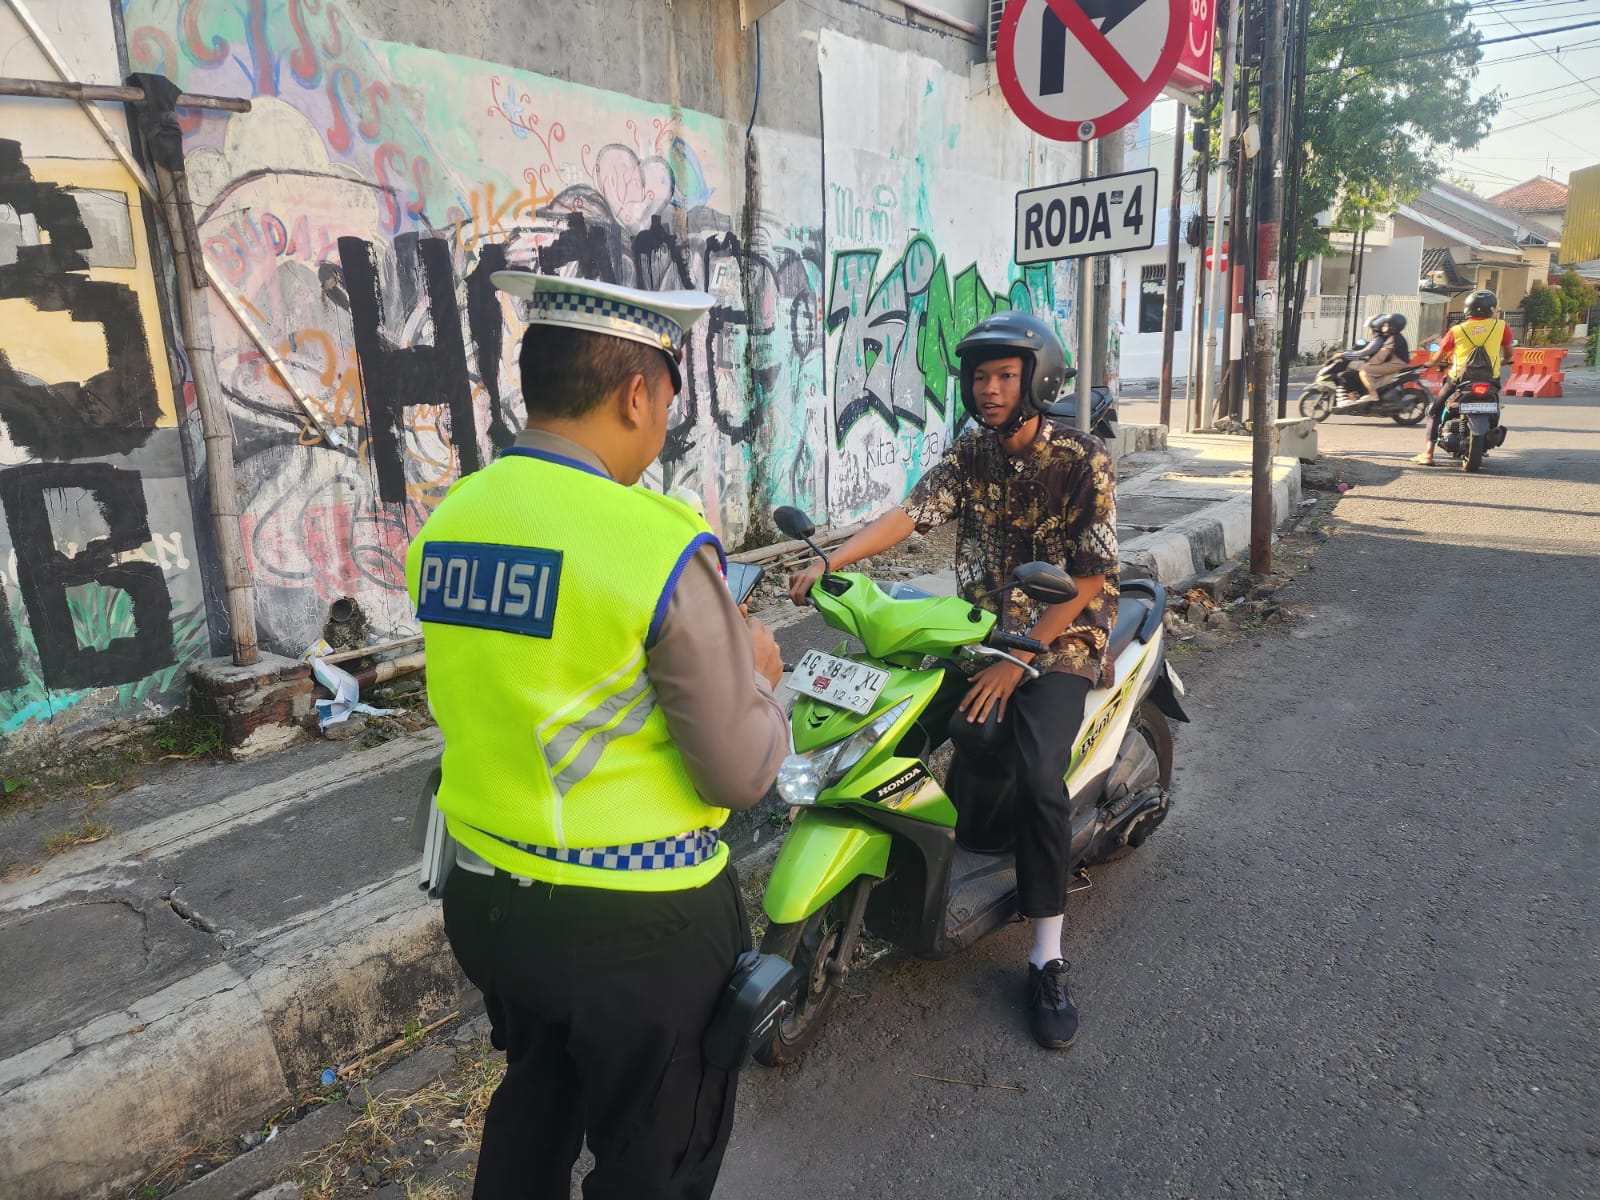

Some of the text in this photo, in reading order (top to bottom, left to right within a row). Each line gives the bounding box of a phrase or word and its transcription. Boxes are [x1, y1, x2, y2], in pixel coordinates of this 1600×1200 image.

[1025, 185, 1143, 250] RODA 4
[420, 556, 550, 619] POLISI
[862, 671, 880, 692] XL
[877, 768, 921, 797] HONDA
